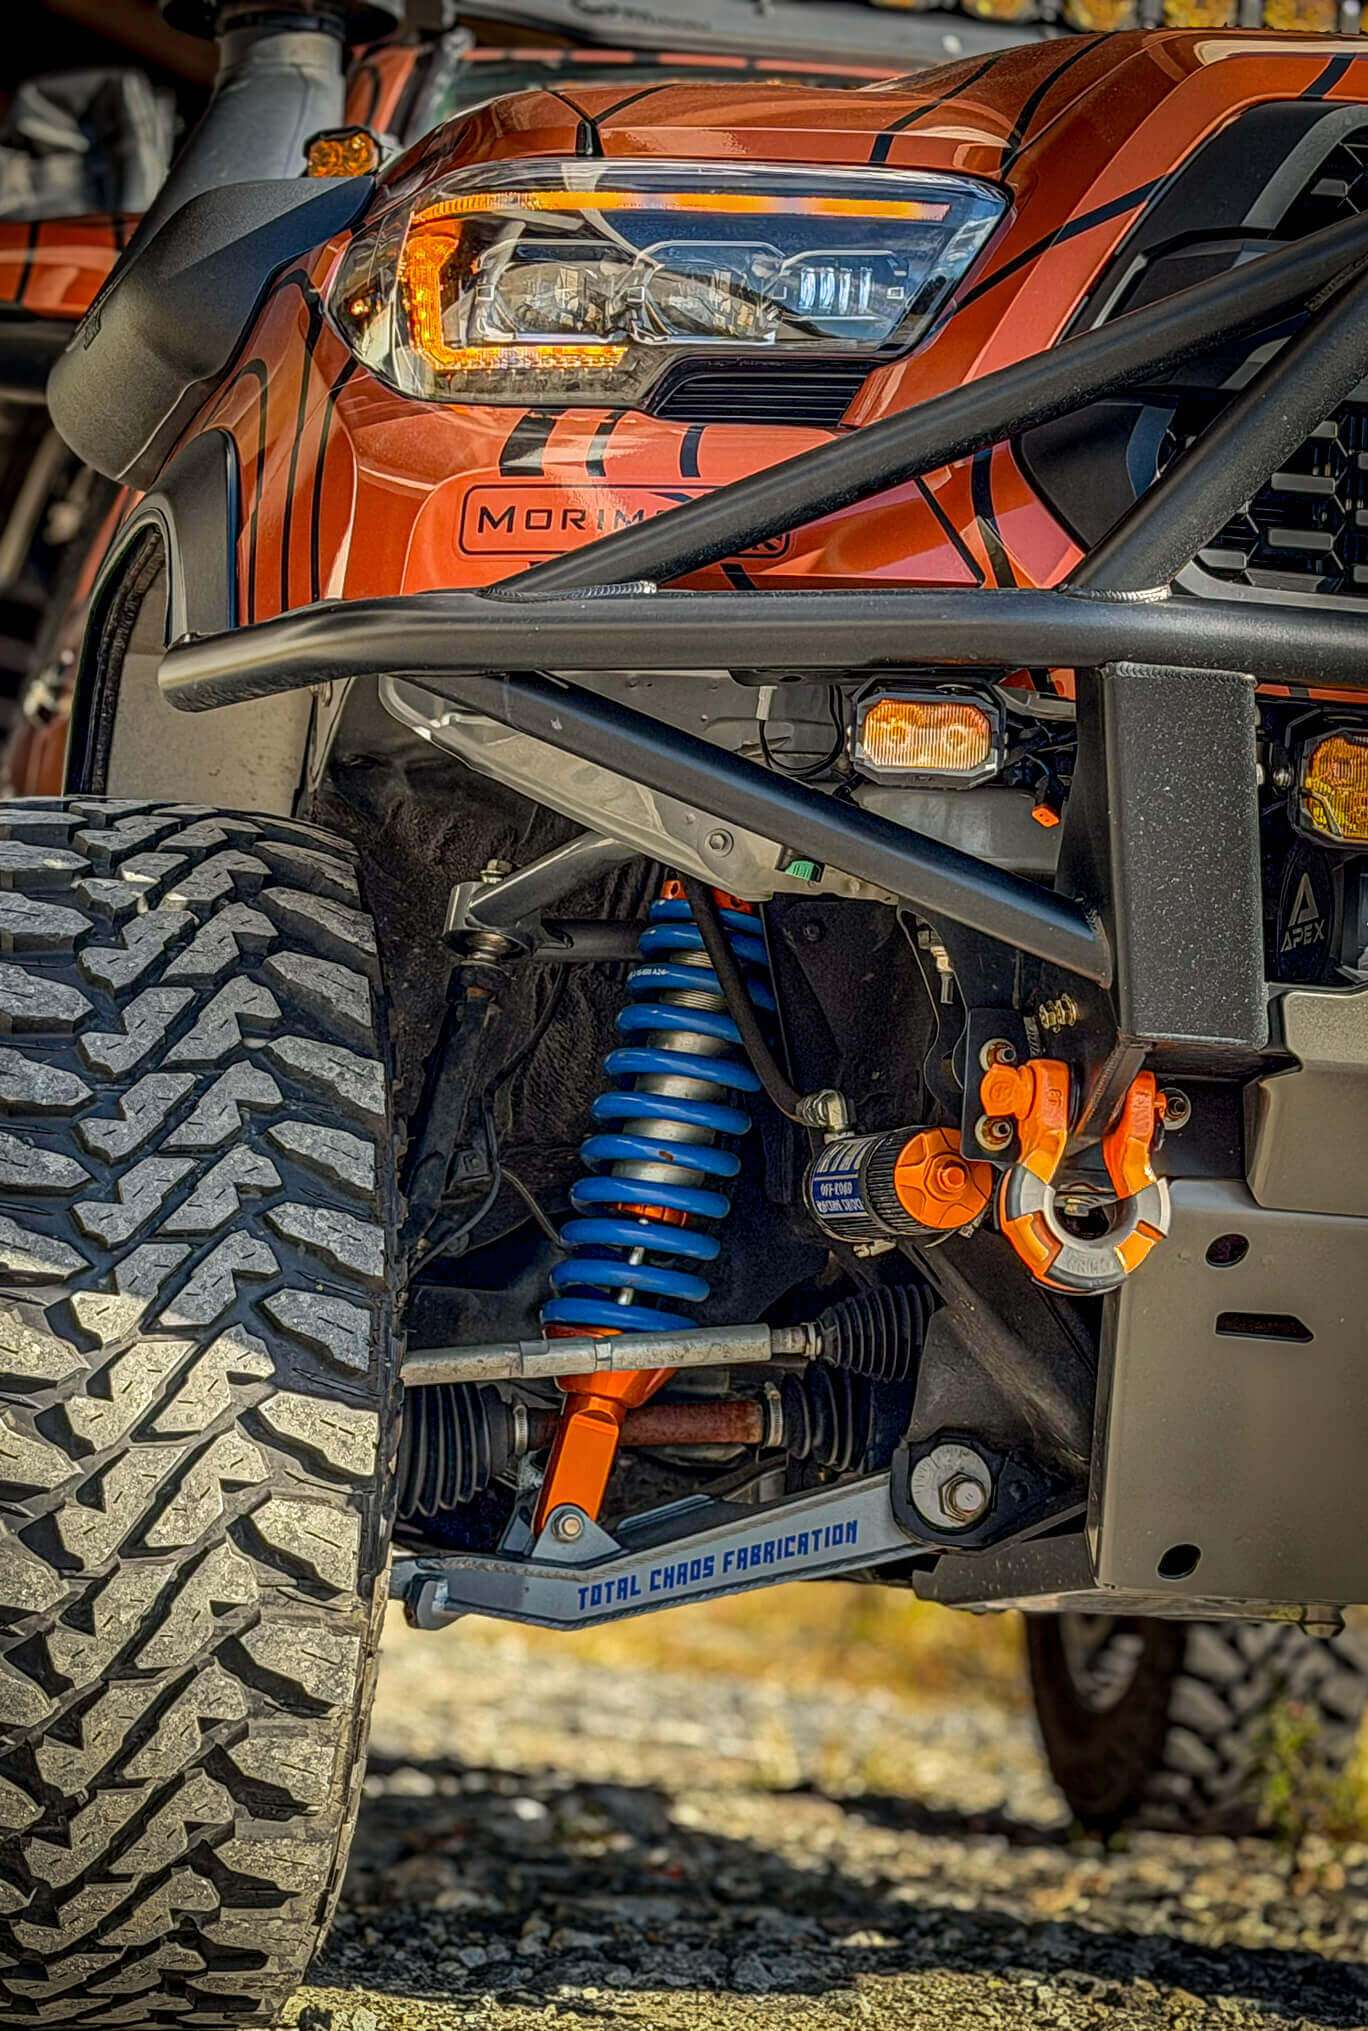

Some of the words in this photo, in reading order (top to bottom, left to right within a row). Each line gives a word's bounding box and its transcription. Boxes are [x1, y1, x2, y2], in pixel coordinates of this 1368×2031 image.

[477, 506, 664, 531] MORIM
[1280, 920, 1325, 952] APEX
[578, 1575, 641, 1610] TOTAL
[650, 1555, 715, 1591] CHAOS
[722, 1520, 858, 1573] FABRICATION
